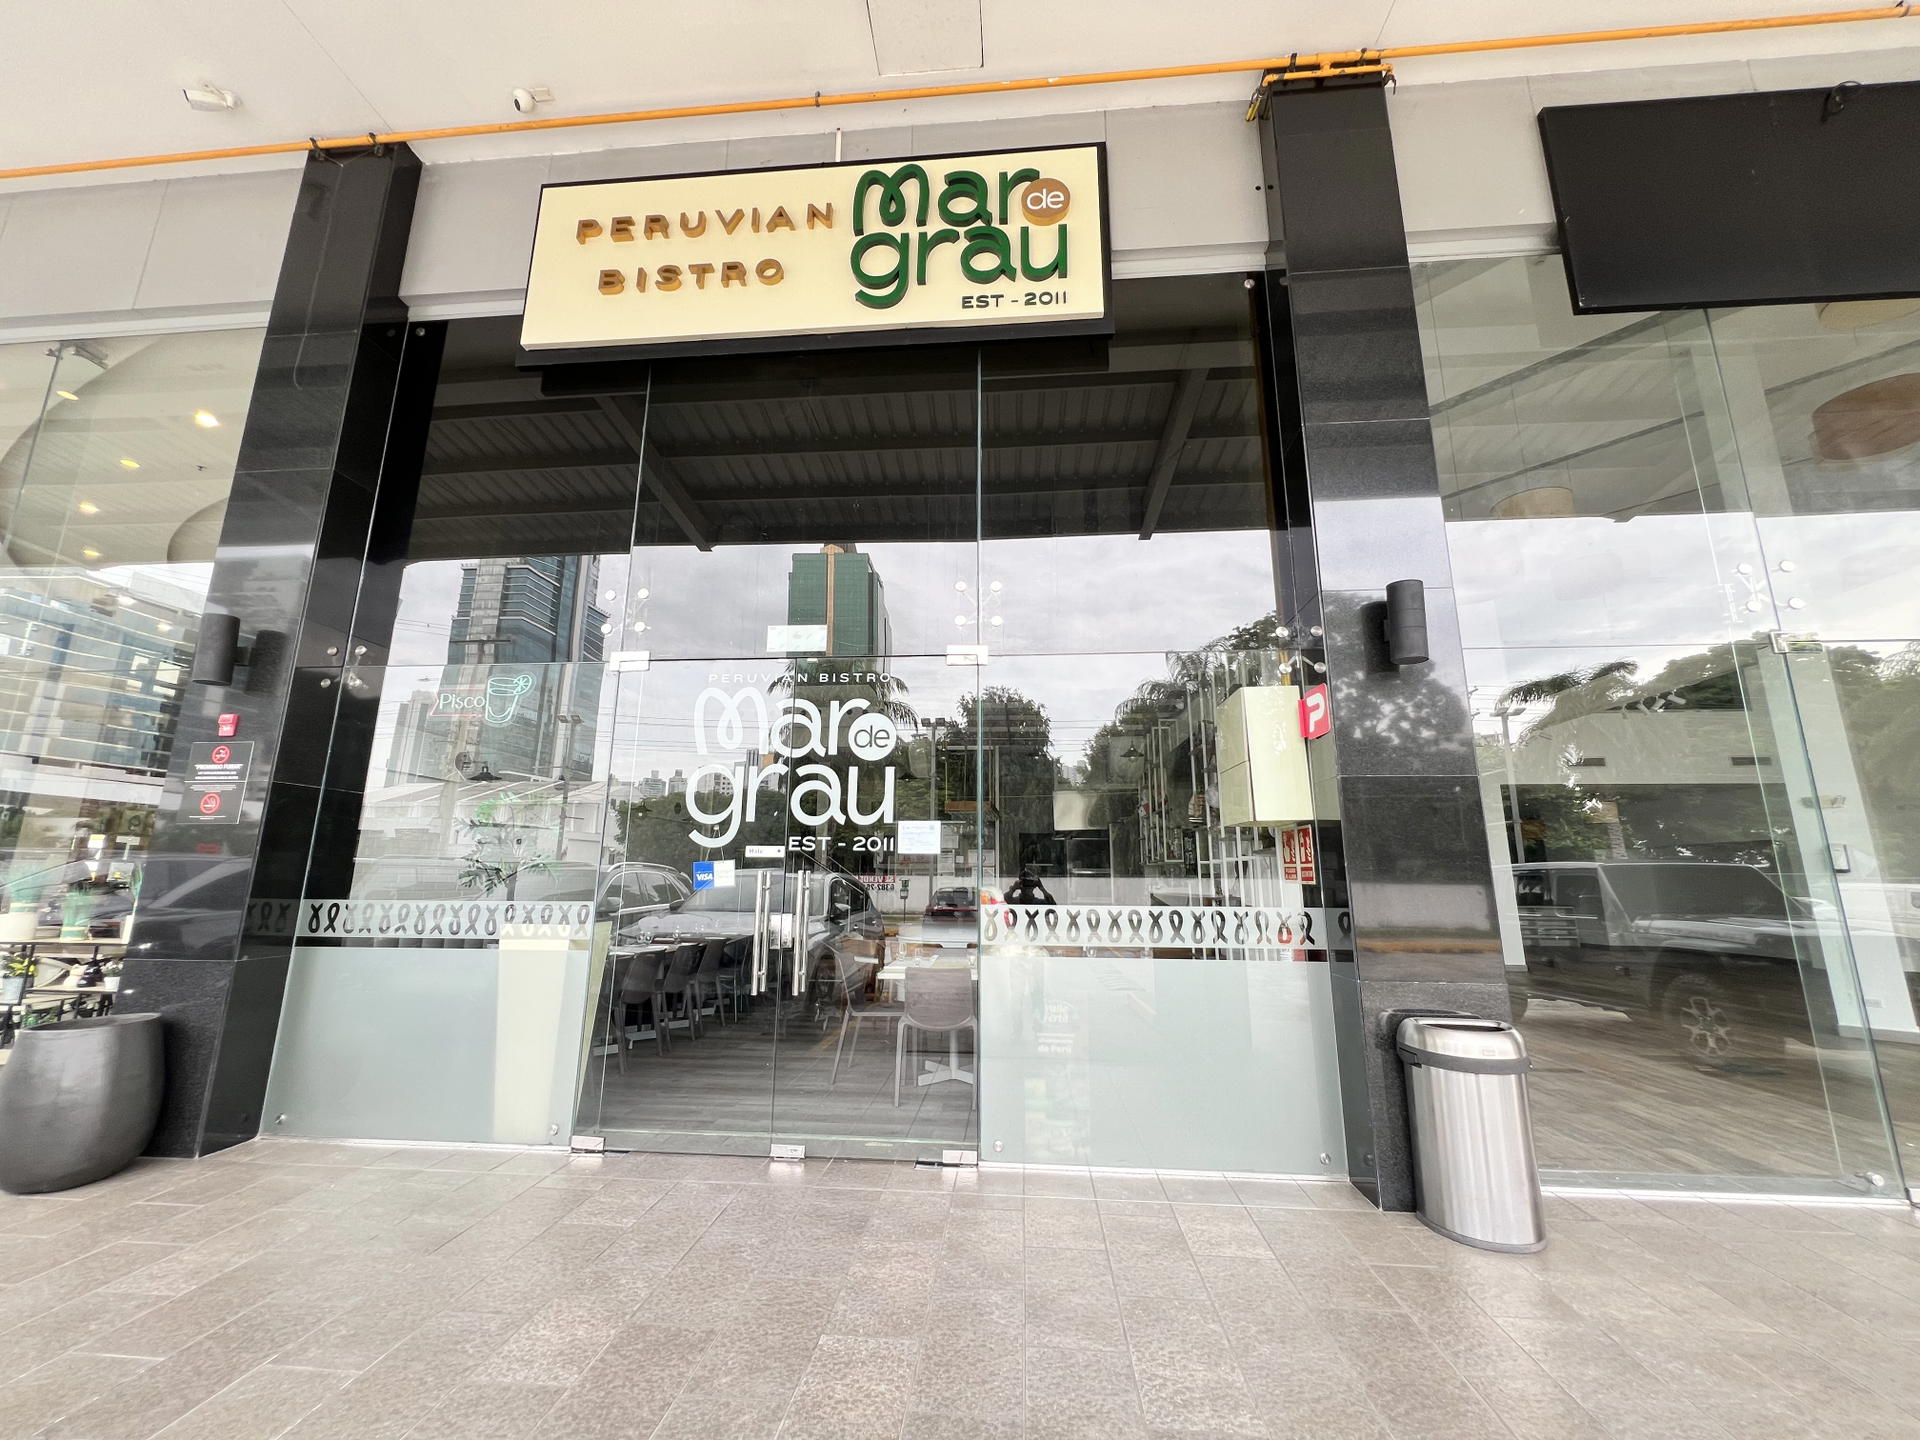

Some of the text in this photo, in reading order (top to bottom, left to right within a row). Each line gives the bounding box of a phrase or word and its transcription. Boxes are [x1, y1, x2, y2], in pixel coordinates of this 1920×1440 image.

[1026, 187, 1065, 211] de
[576, 202, 834, 245] PERUVIAN
[598, 258, 785, 296] BISTRO
[850, 223, 1069, 309] grau
[961, 295, 1001, 309] EST
[1024, 291, 1068, 306] 2011
[708, 672, 891, 684] PERUVIAN BISTRO
[439, 693, 485, 710] Pisco
[853, 724, 890, 749] de
[685, 763, 896, 848] grau
[788, 836, 831, 850] EST
[852, 836, 895, 851] 2011
[696, 872, 714, 881] VISA
